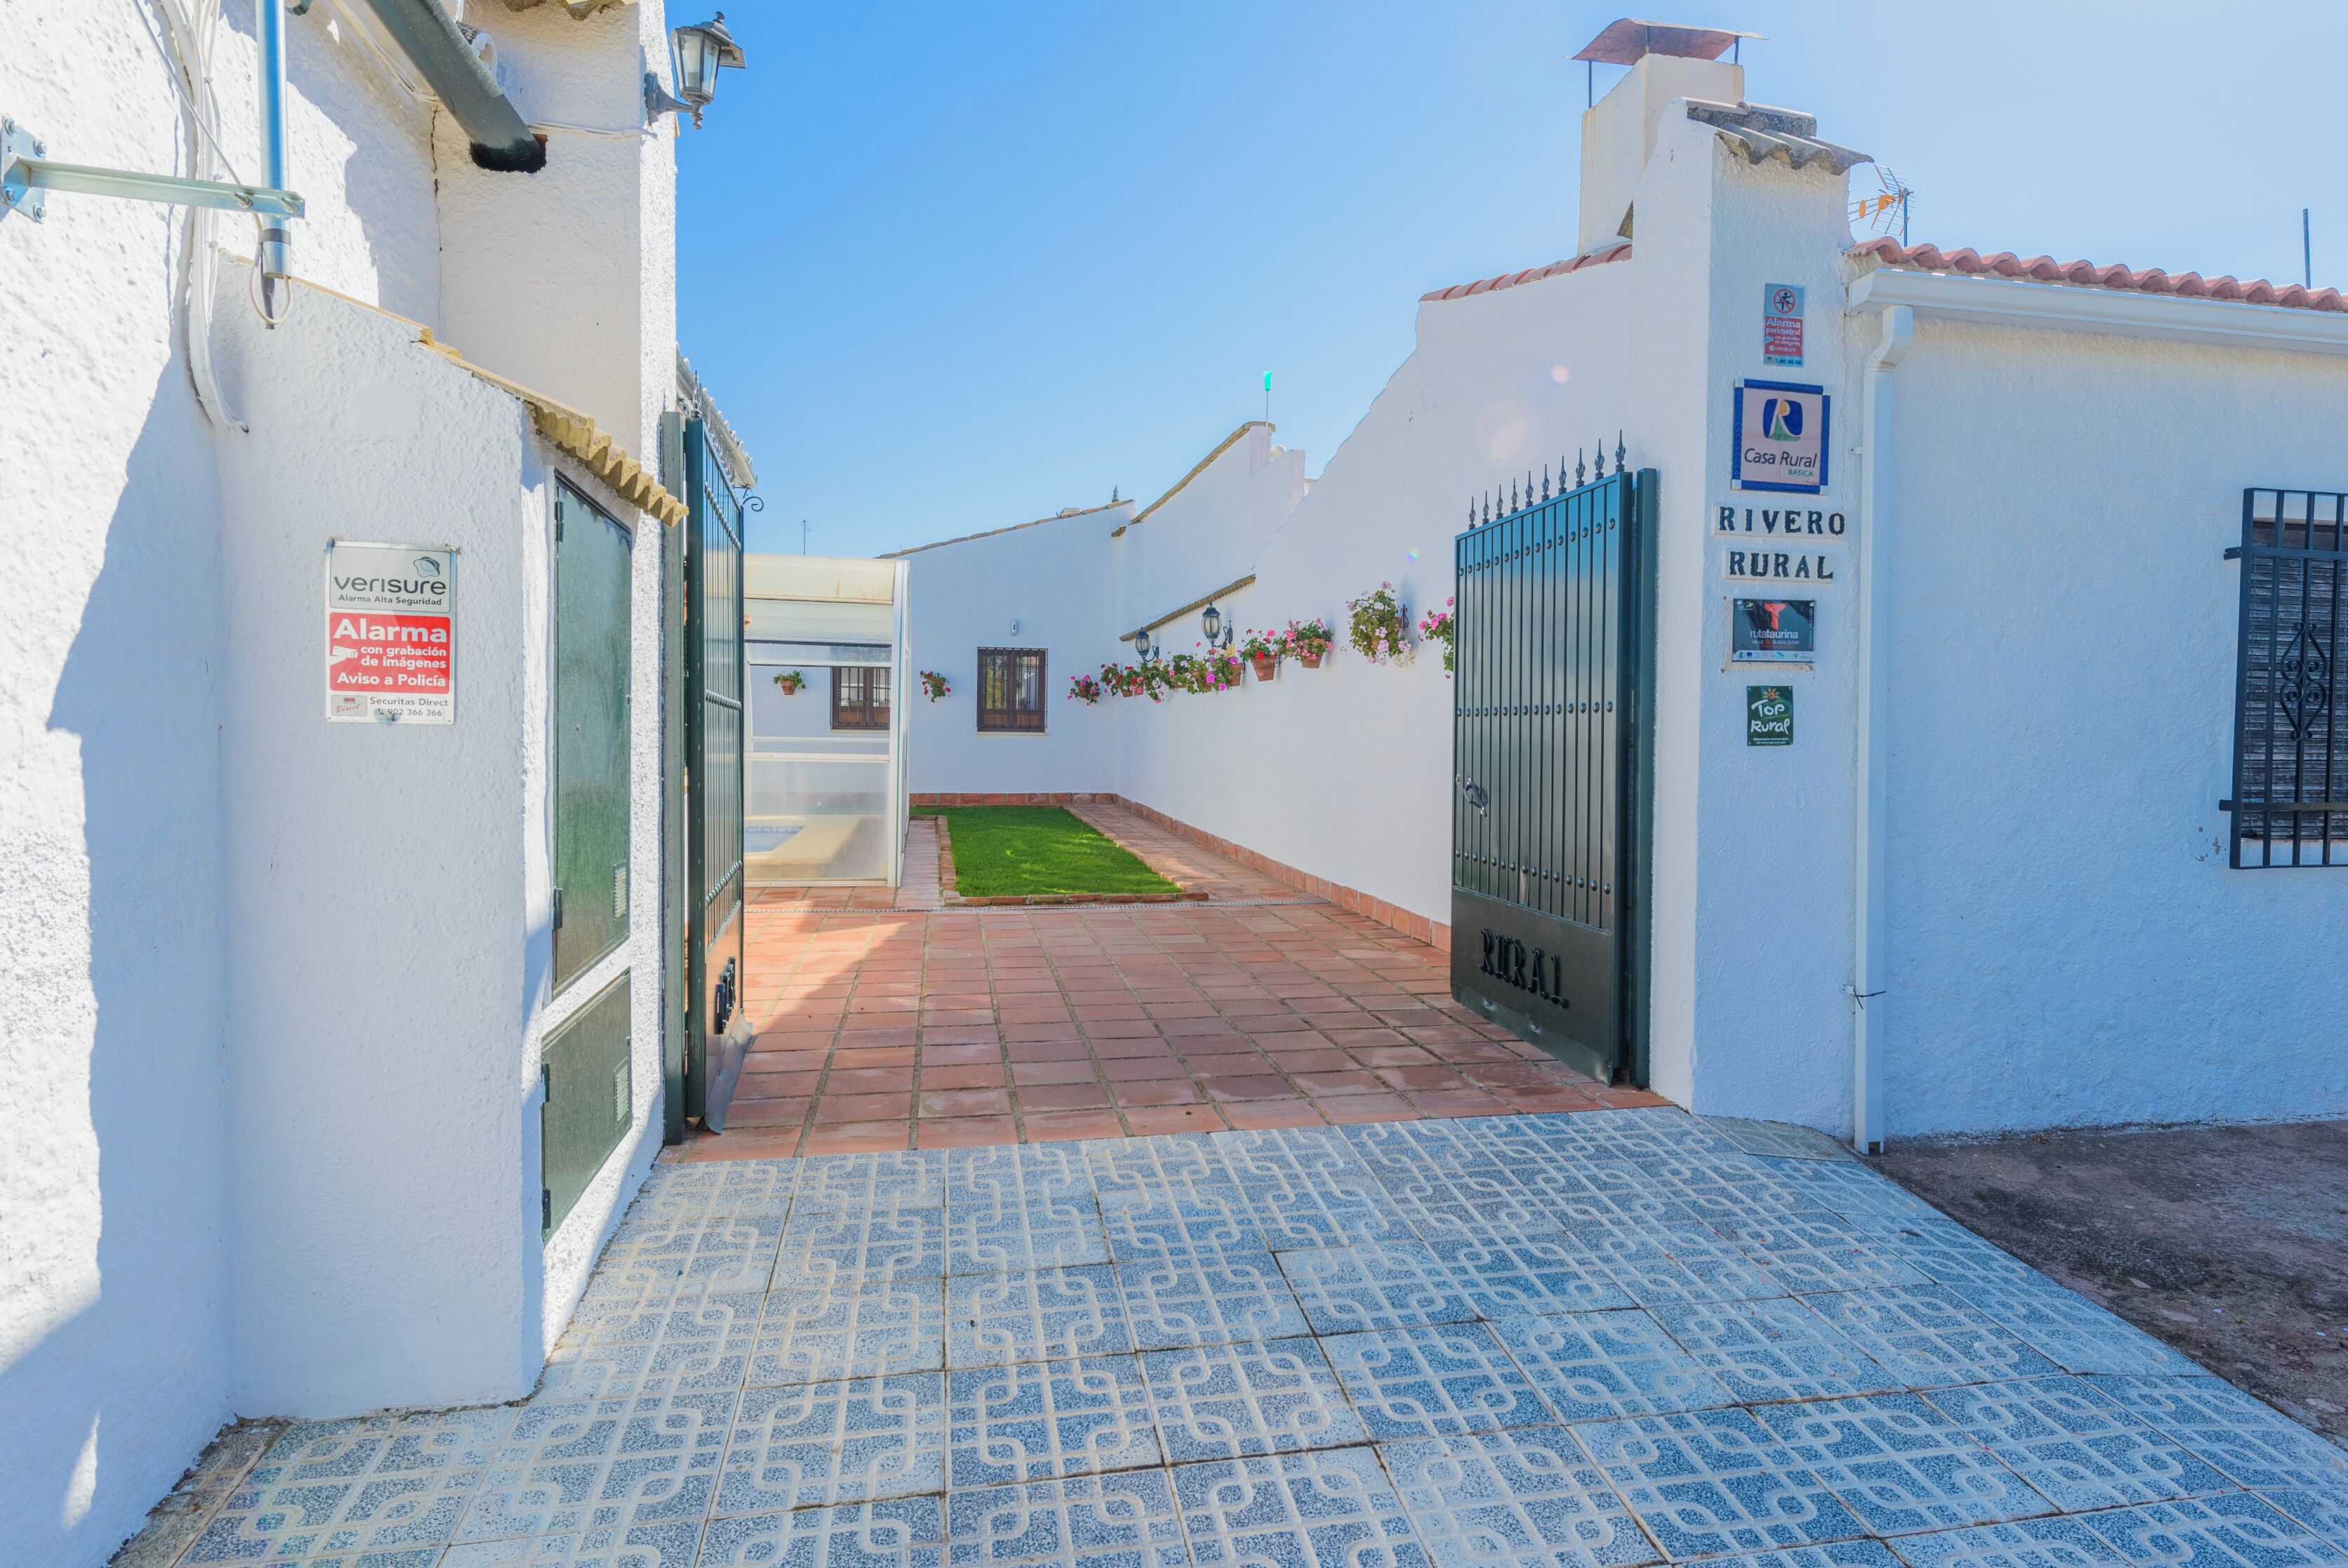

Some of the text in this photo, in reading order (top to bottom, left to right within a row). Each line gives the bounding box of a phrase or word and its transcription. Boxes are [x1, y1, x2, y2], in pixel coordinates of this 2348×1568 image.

[1766, 317, 1801, 328] Alarma
[1766, 327, 1801, 336] perimetral
[1744, 447, 1818, 468] Casa Rural
[1719, 506, 1845, 536] RIVERO
[1729, 551, 1833, 579] RURAL
[334, 576, 447, 595] verisure
[338, 594, 442, 606] Alarma Alta Seguridad
[333, 618, 447, 643] Alarma
[386, 647, 447, 657] grabación
[361, 656, 447, 669] de imágenes
[336, 672, 446, 687] Aviso a Policía
[370, 697, 449, 706] Securitas Direct
[1750, 718, 1790, 734] Rural
